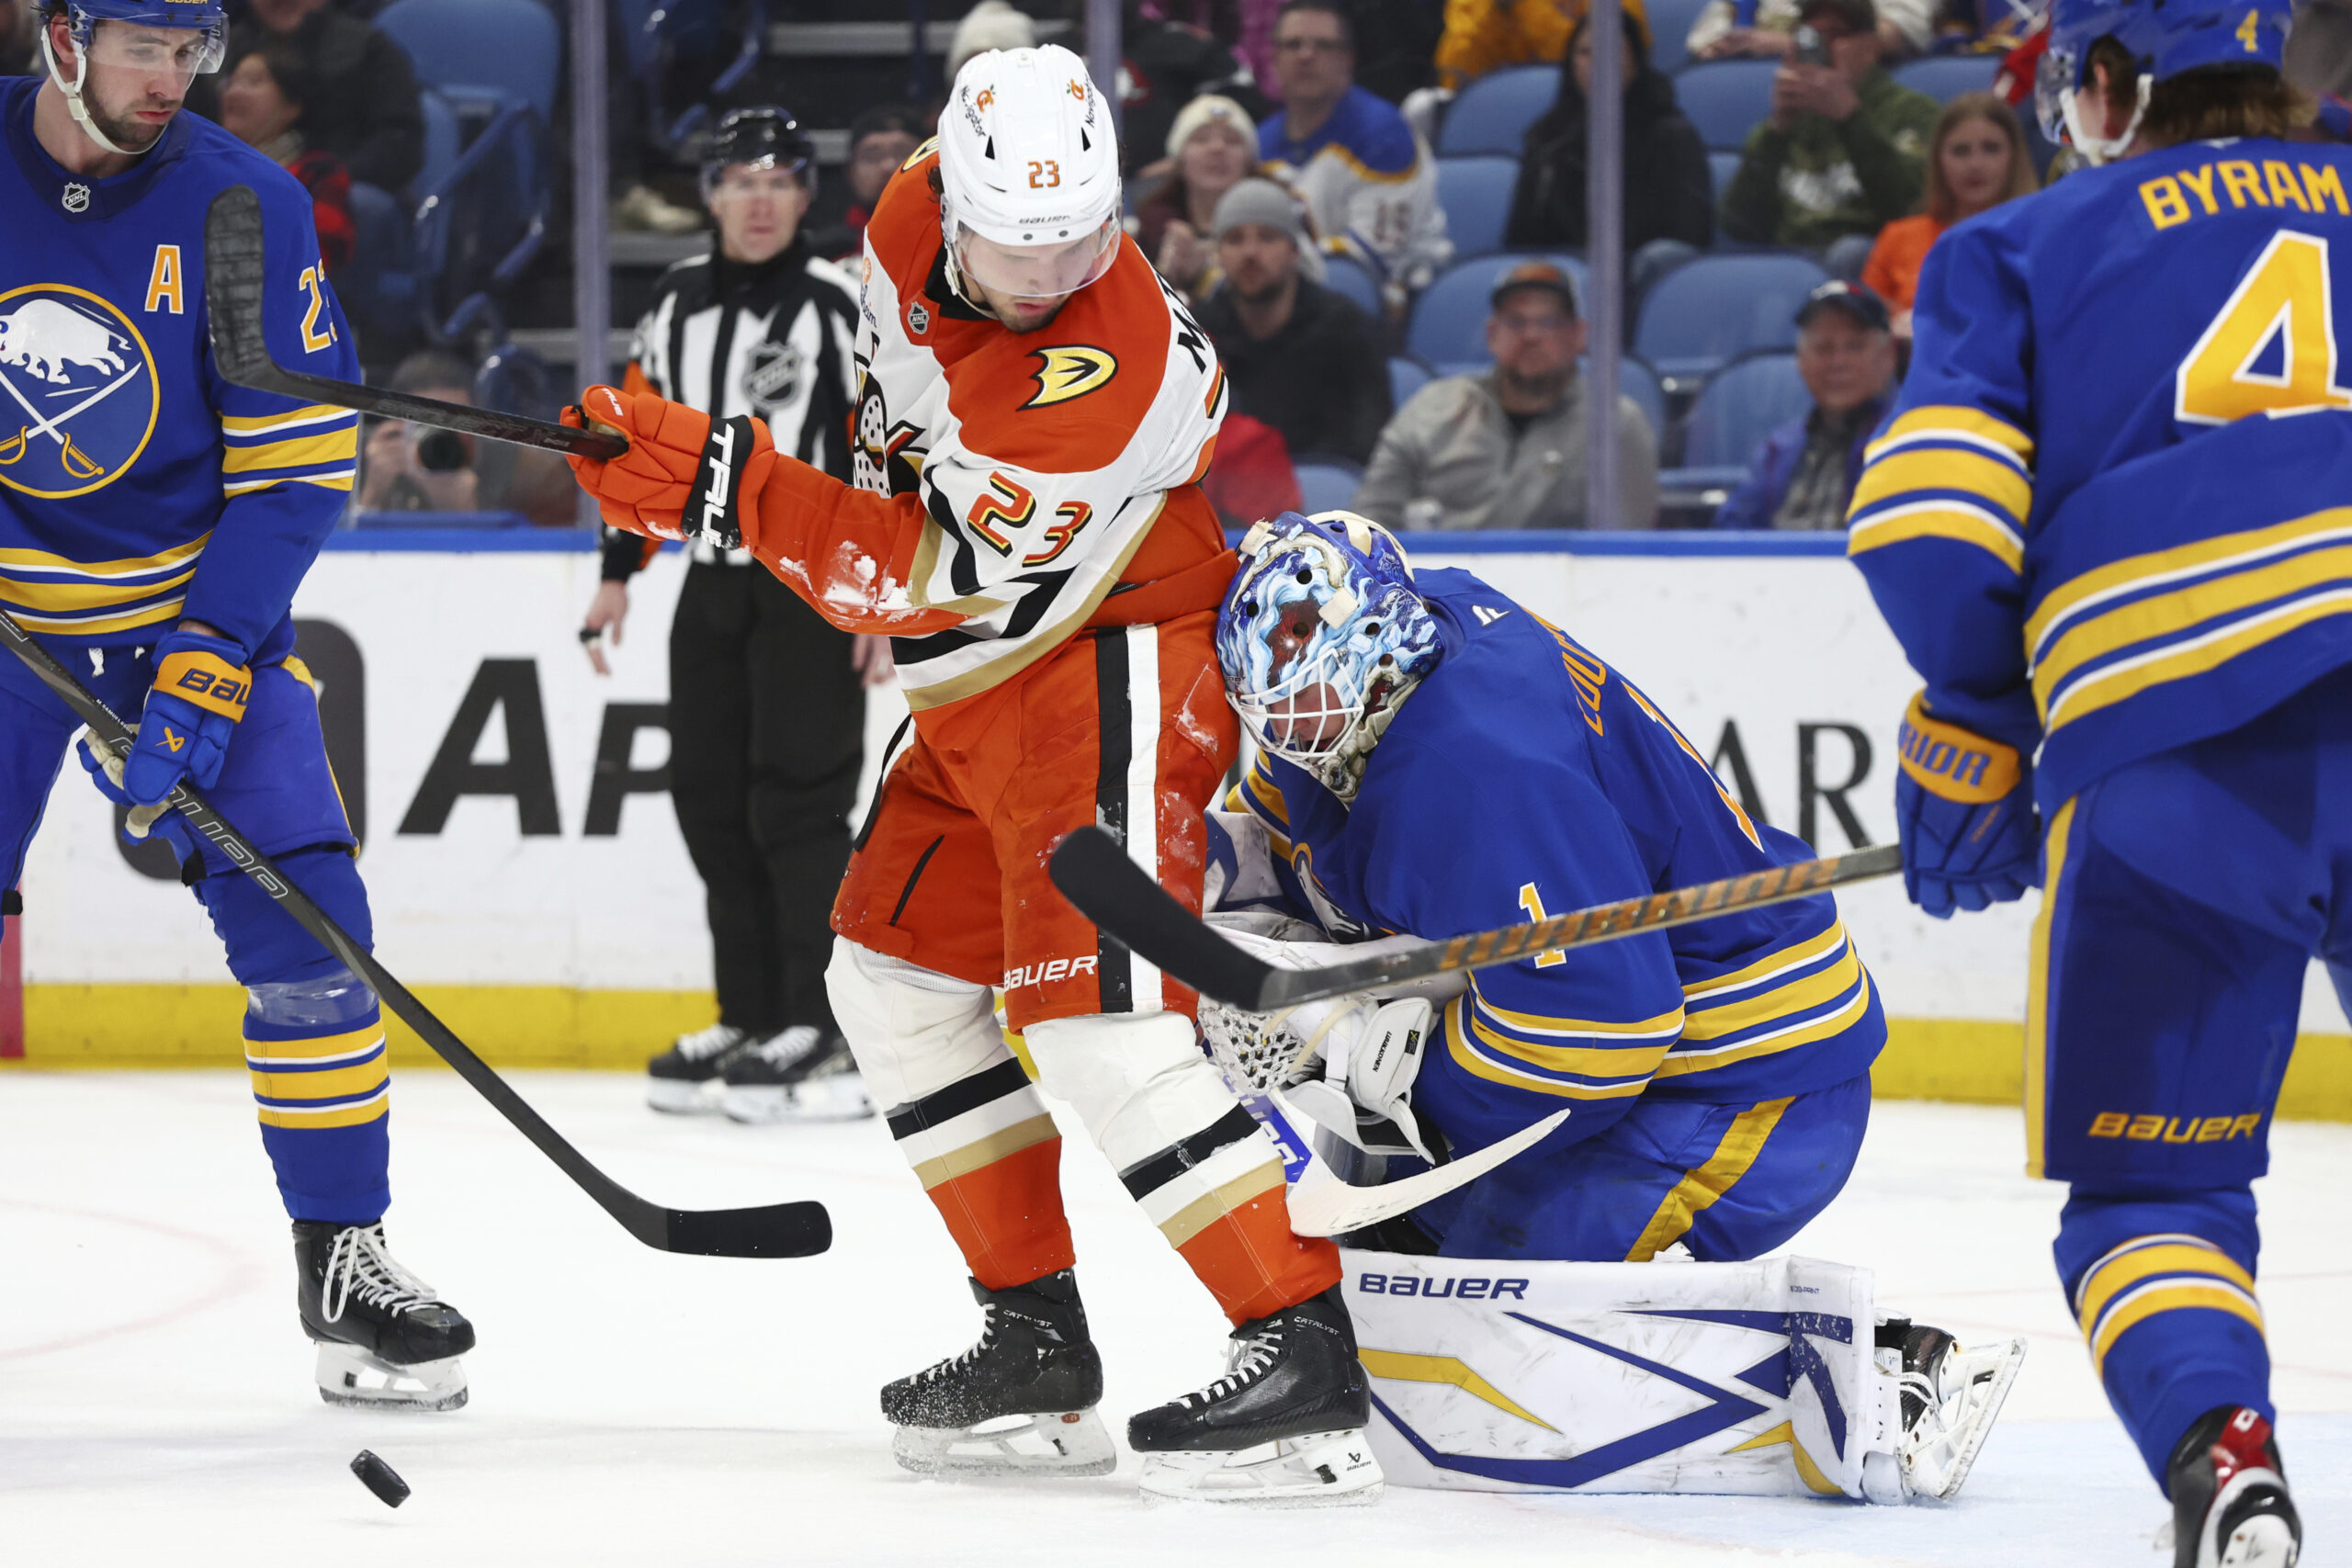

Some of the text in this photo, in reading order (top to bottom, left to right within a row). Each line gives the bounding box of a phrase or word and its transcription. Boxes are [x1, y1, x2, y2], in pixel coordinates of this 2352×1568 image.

[2235, 8, 2259, 52] 4
[1027, 160, 1060, 189] 23
[2138, 159, 2351, 231] BYRAM
[68, 192, 85, 205] NHL
[144, 243, 184, 315] A
[2176, 229, 2352, 426] 4
[603, 388, 624, 416] TRUE
[701, 423, 735, 548] TRUE
[967, 470, 1093, 569] 23
[1519, 881, 1567, 969] 1
[1004, 954, 1099, 992] BAUER
[2088, 1111, 2263, 1144] BAUER
[1359, 1272, 1530, 1301] BAUER
